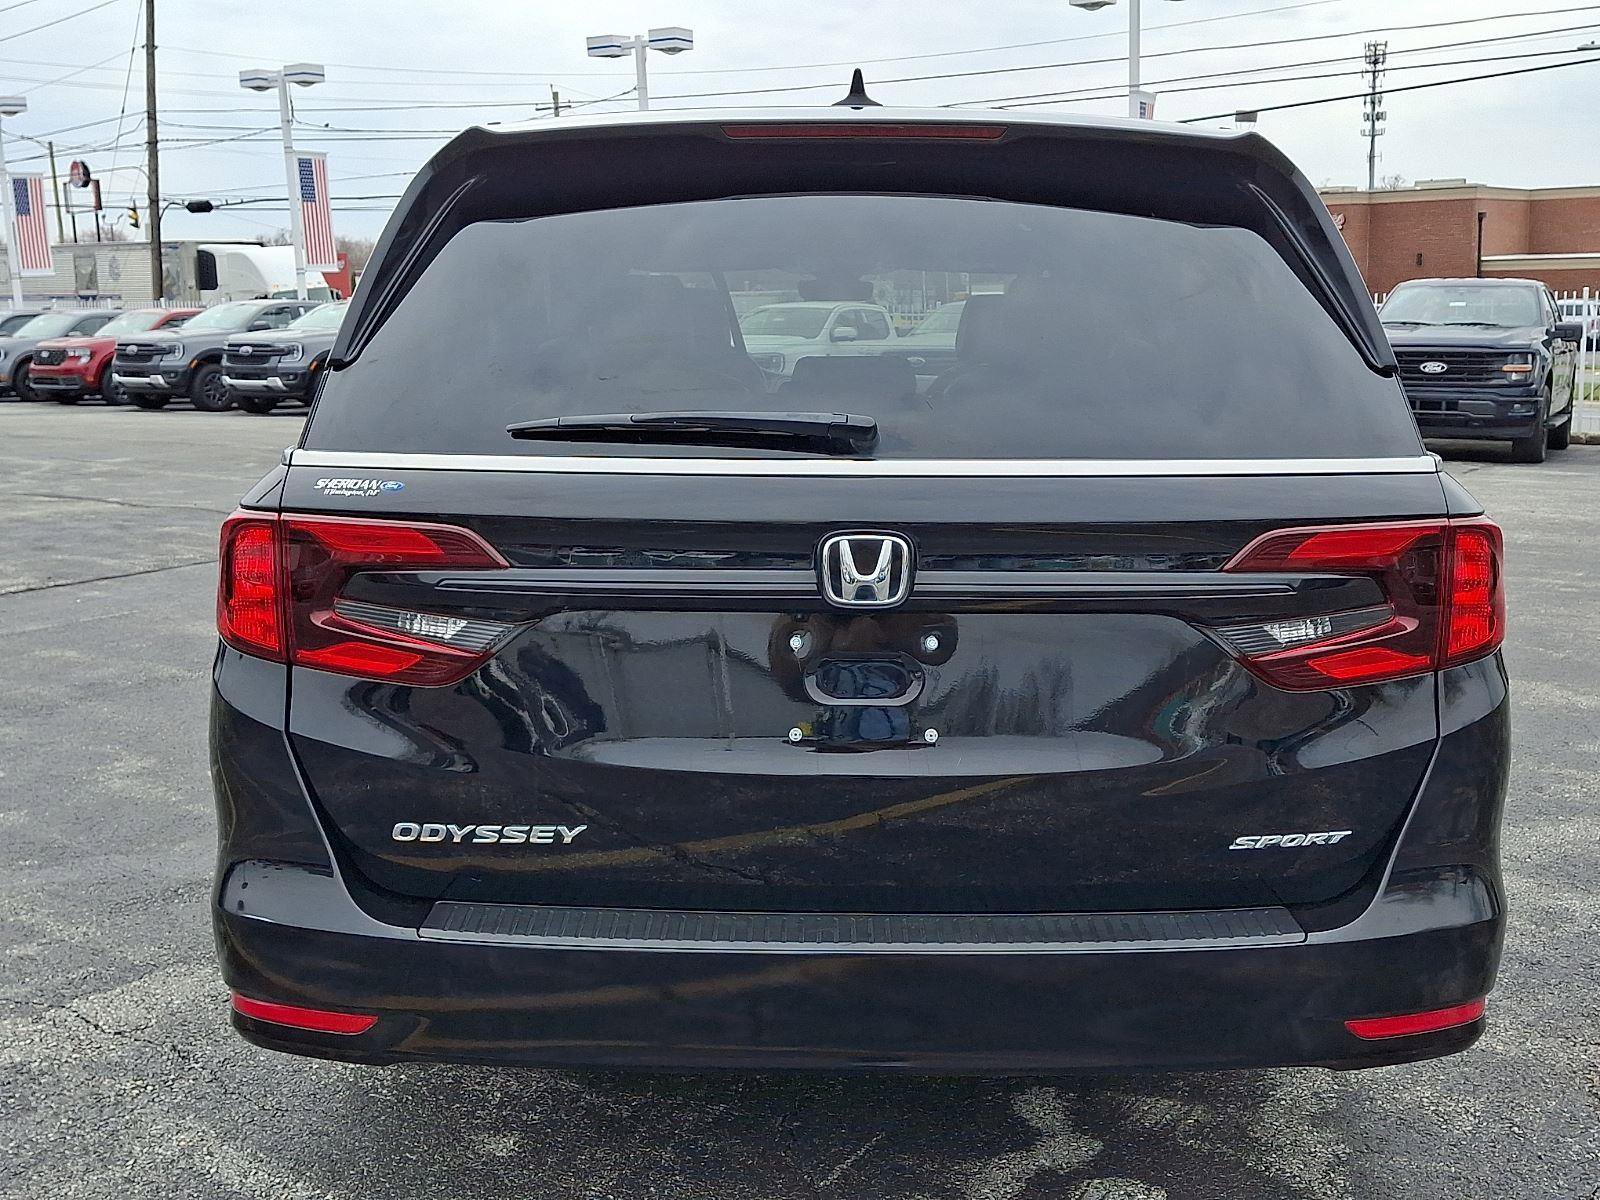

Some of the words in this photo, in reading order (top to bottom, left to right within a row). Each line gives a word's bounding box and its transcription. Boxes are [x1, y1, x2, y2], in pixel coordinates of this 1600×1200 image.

[314, 478, 382, 489] SHERIDAN
[392, 822, 588, 844] ODYSSEY
[1228, 830, 1353, 850] SPORT
